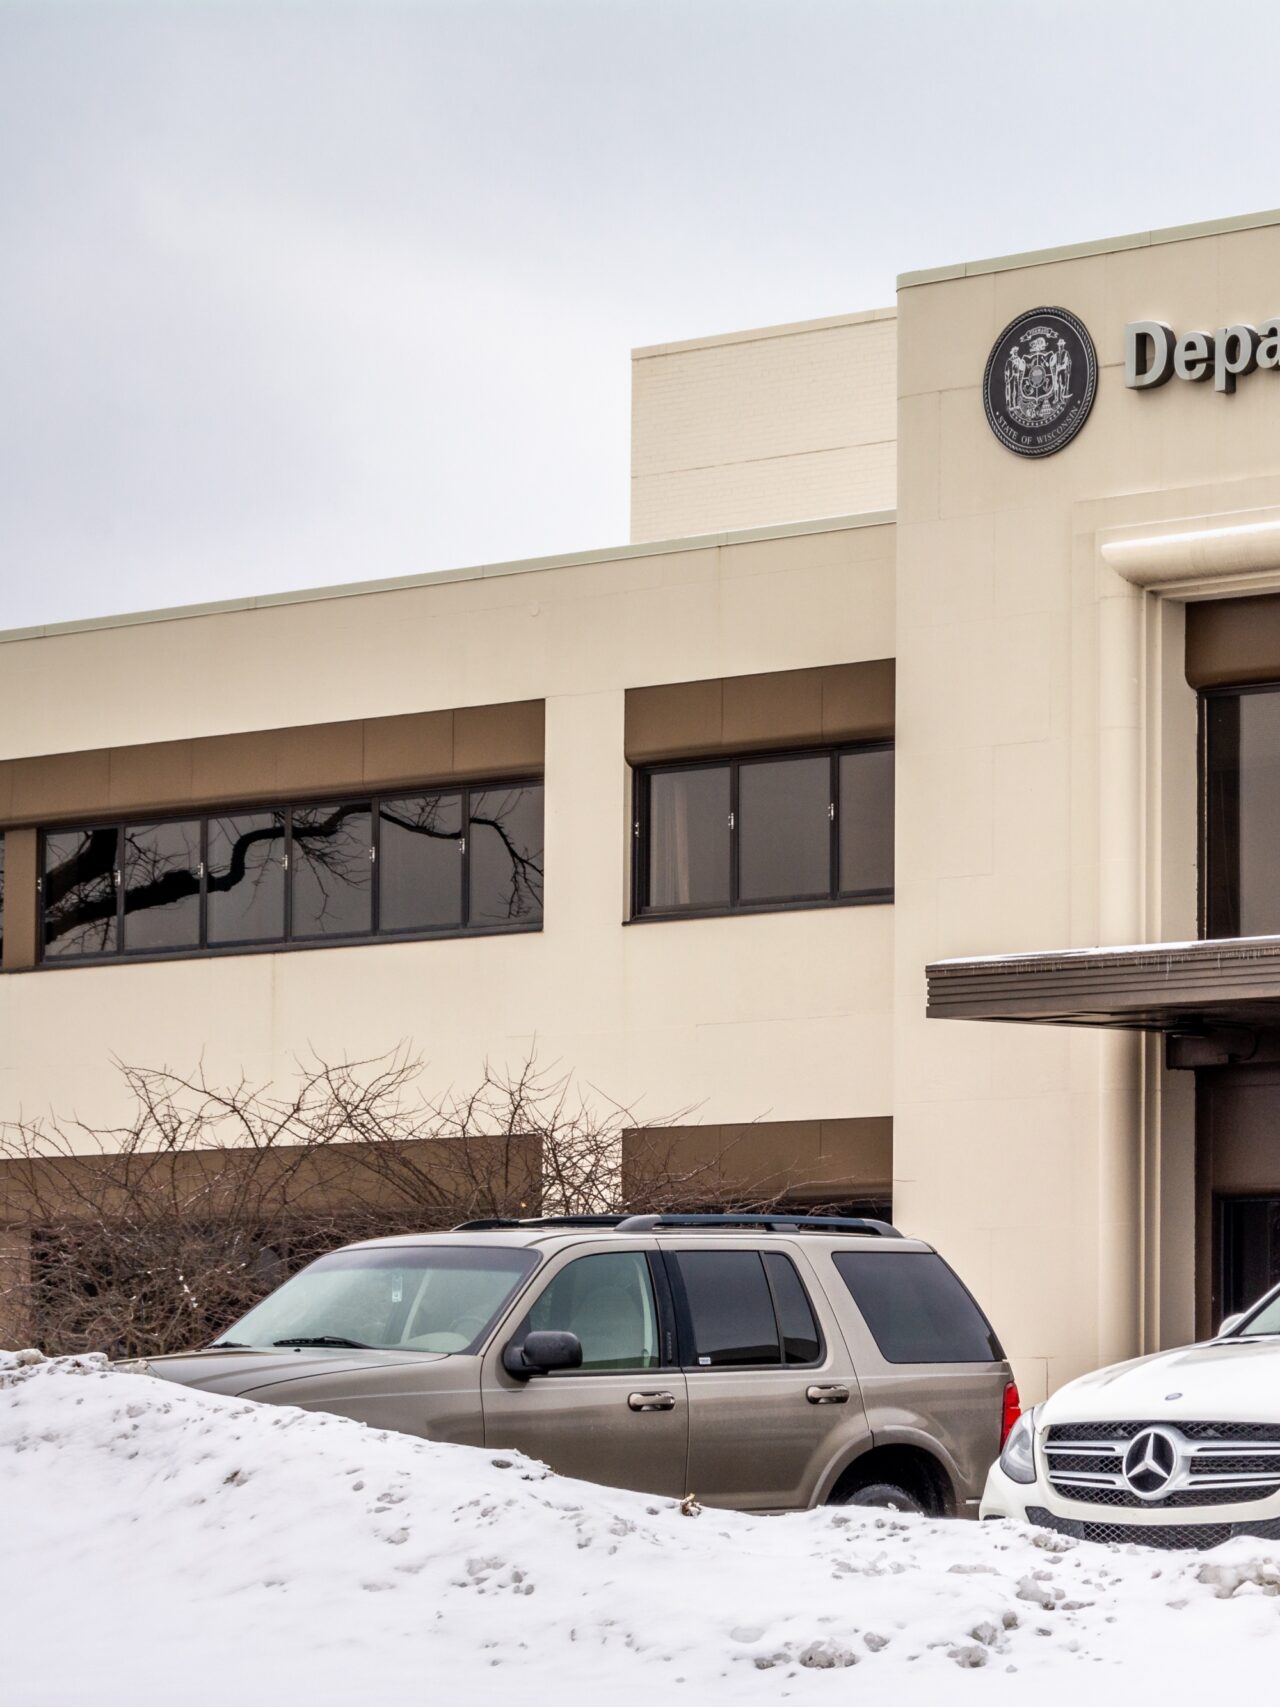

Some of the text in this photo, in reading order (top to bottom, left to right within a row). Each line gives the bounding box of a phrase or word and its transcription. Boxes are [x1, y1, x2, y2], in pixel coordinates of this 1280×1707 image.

[998, 406, 1078, 445] STATE OF WISCONSIN
